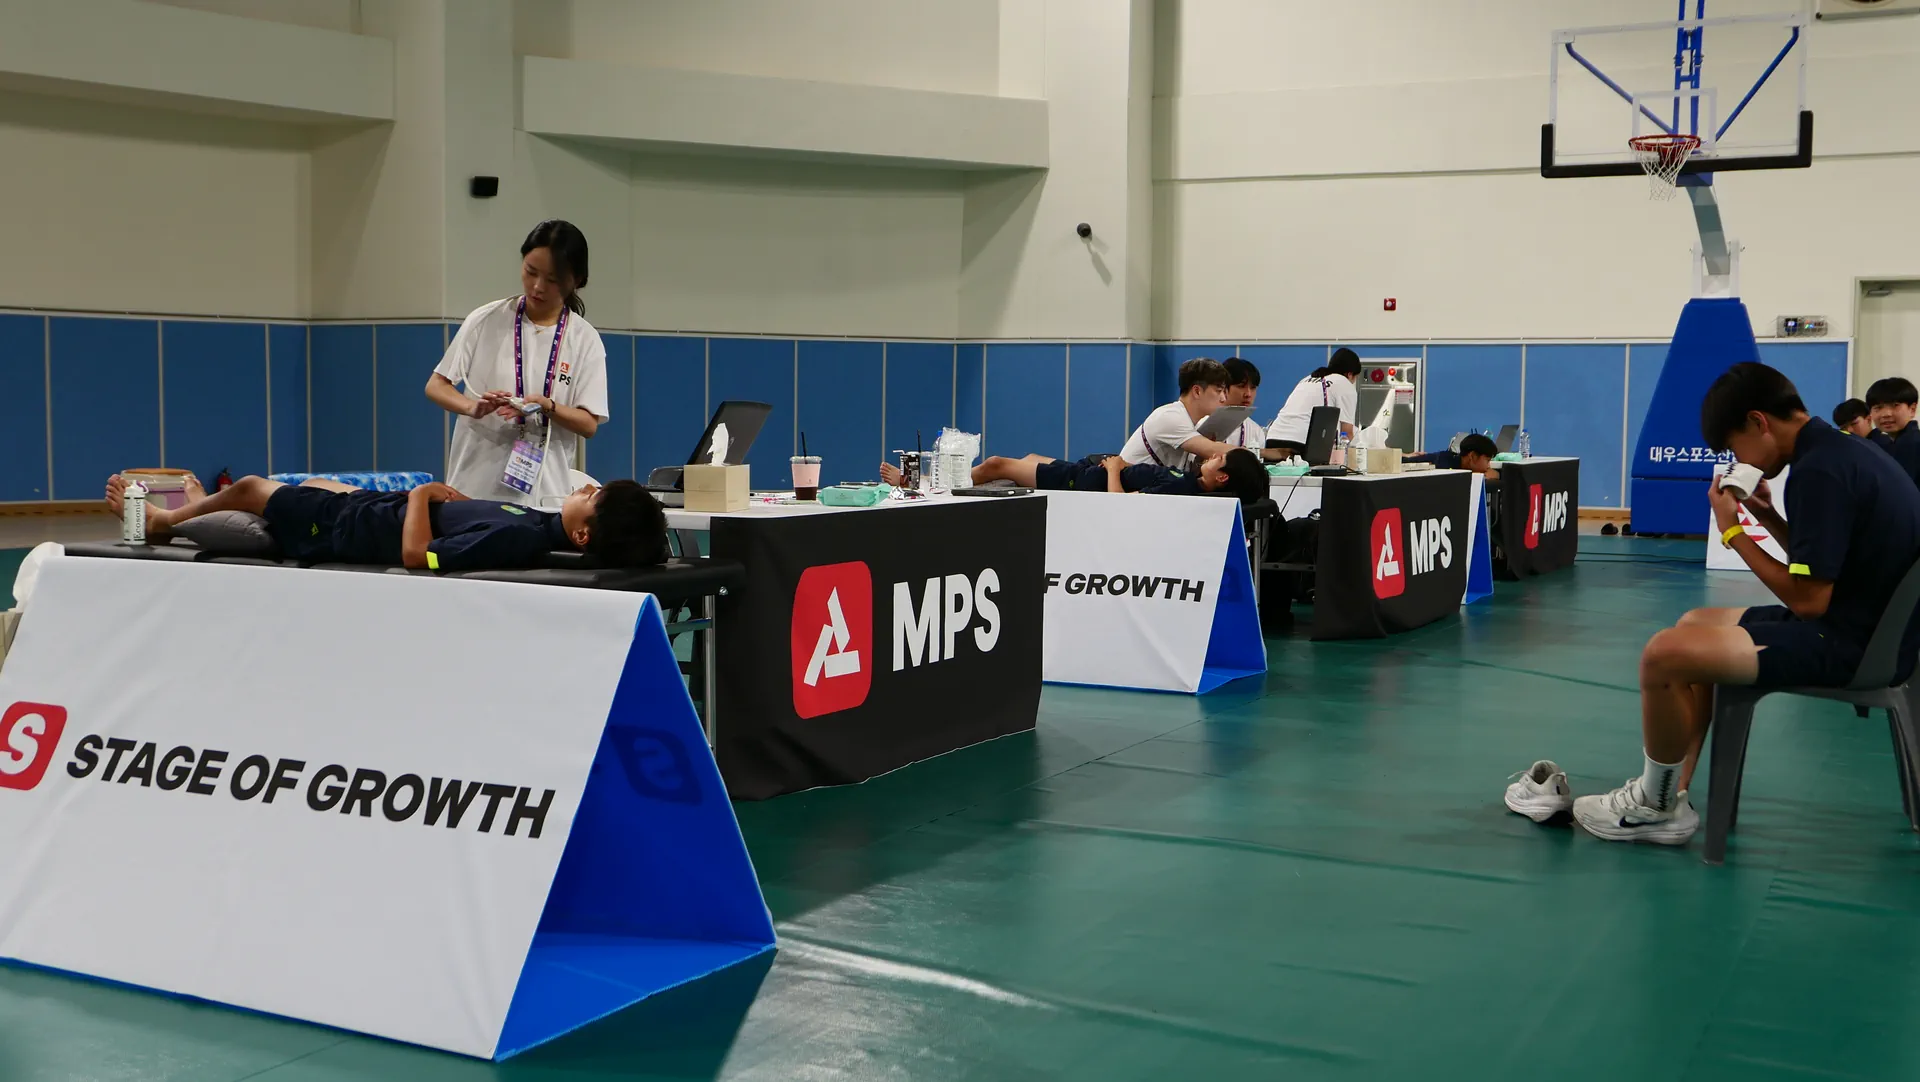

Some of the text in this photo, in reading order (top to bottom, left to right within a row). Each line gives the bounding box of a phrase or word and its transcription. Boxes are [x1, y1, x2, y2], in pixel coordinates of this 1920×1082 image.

[133, 499, 142, 539] Ecosonic
[1542, 490, 1569, 534] MPS
[1410, 515, 1453, 576] MPS
[1065, 573, 1205, 602] GROWTH
[893, 568, 1001, 671] MPS
[67, 735, 228, 796] STAGE
[230, 755, 306, 804] OF
[306, 764, 556, 839] GROWTH
